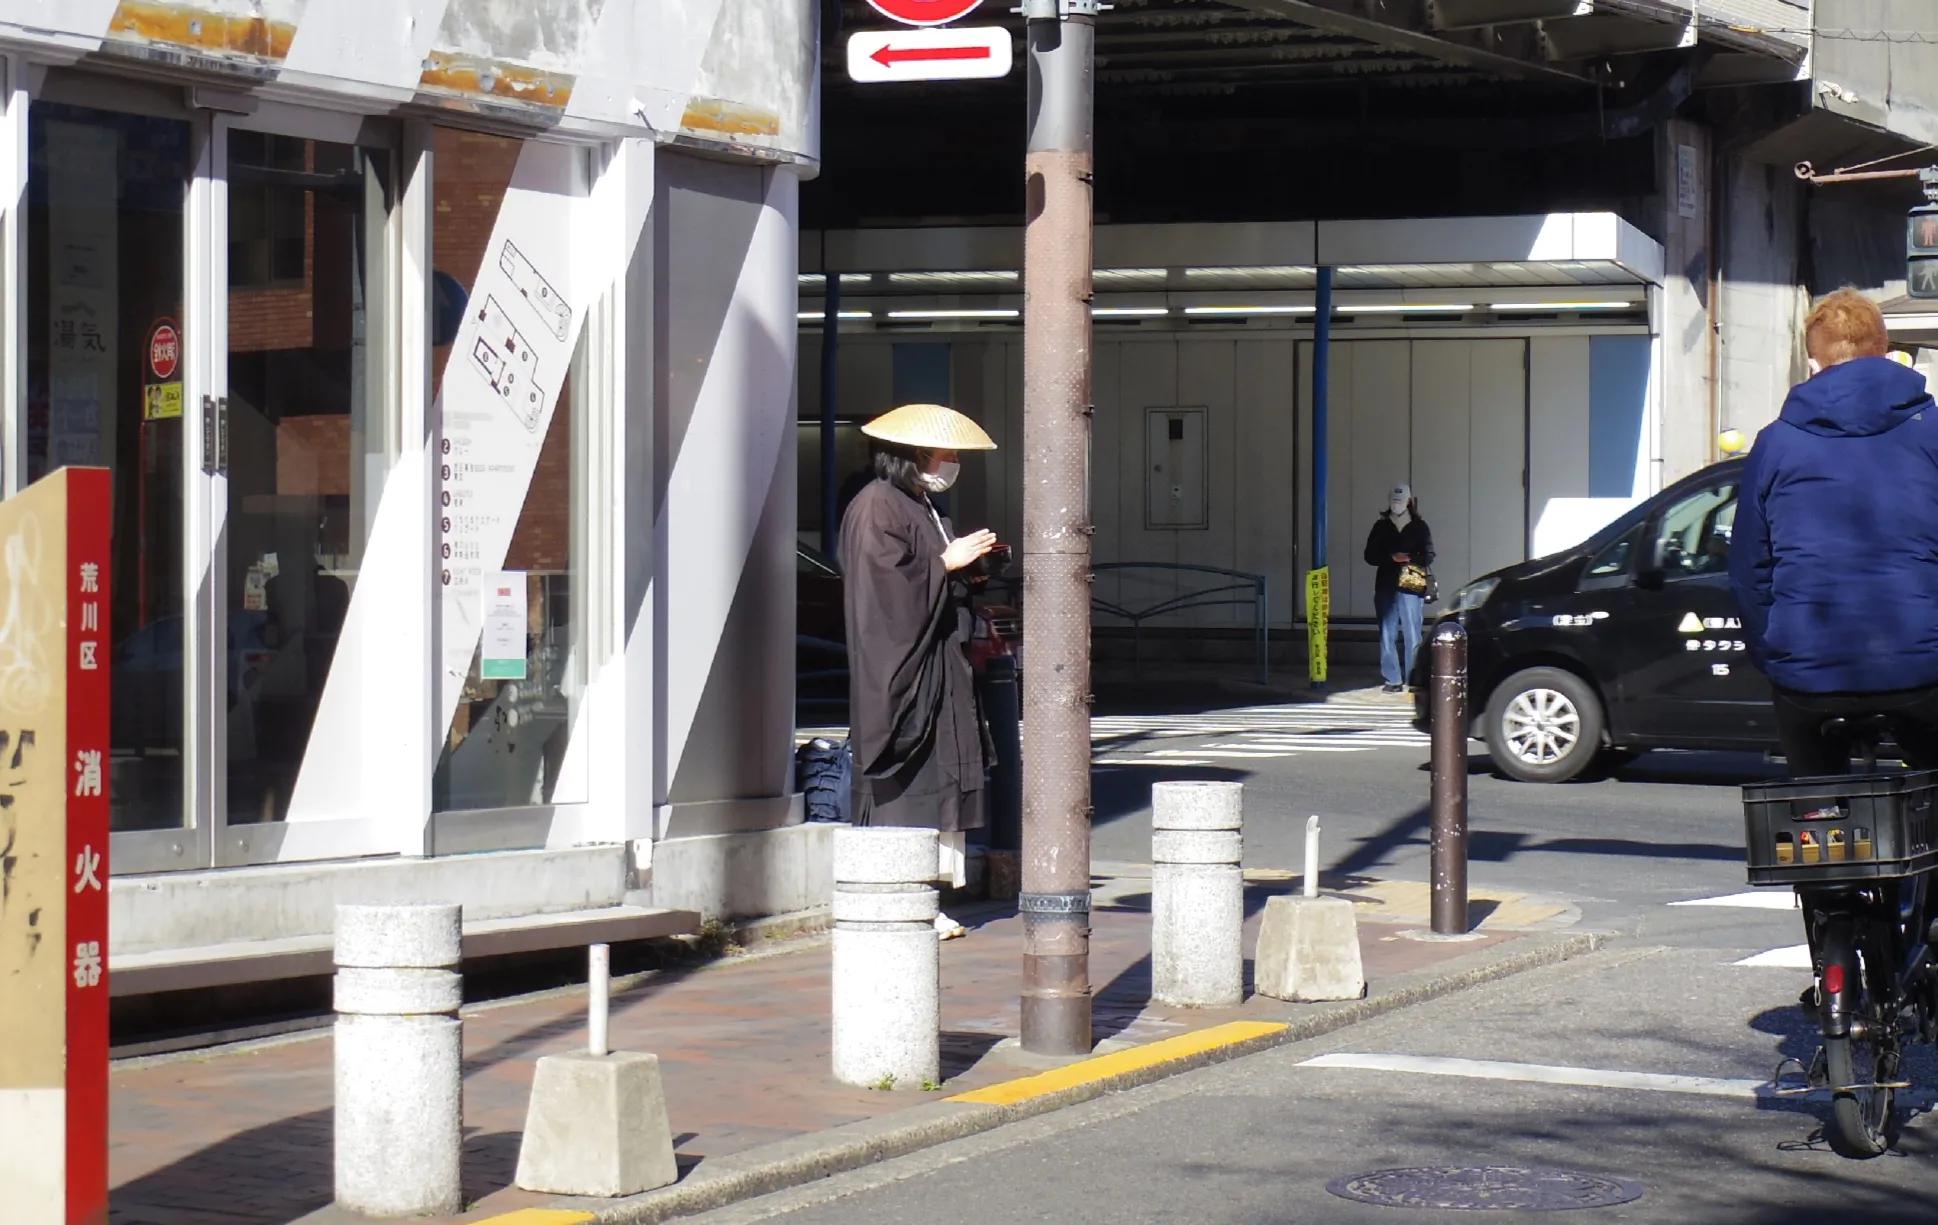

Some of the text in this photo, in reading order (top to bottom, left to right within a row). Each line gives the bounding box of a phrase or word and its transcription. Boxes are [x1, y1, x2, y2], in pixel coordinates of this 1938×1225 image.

[80, 562, 99, 670] 荒川区
[74, 750, 102, 988] 消火器
